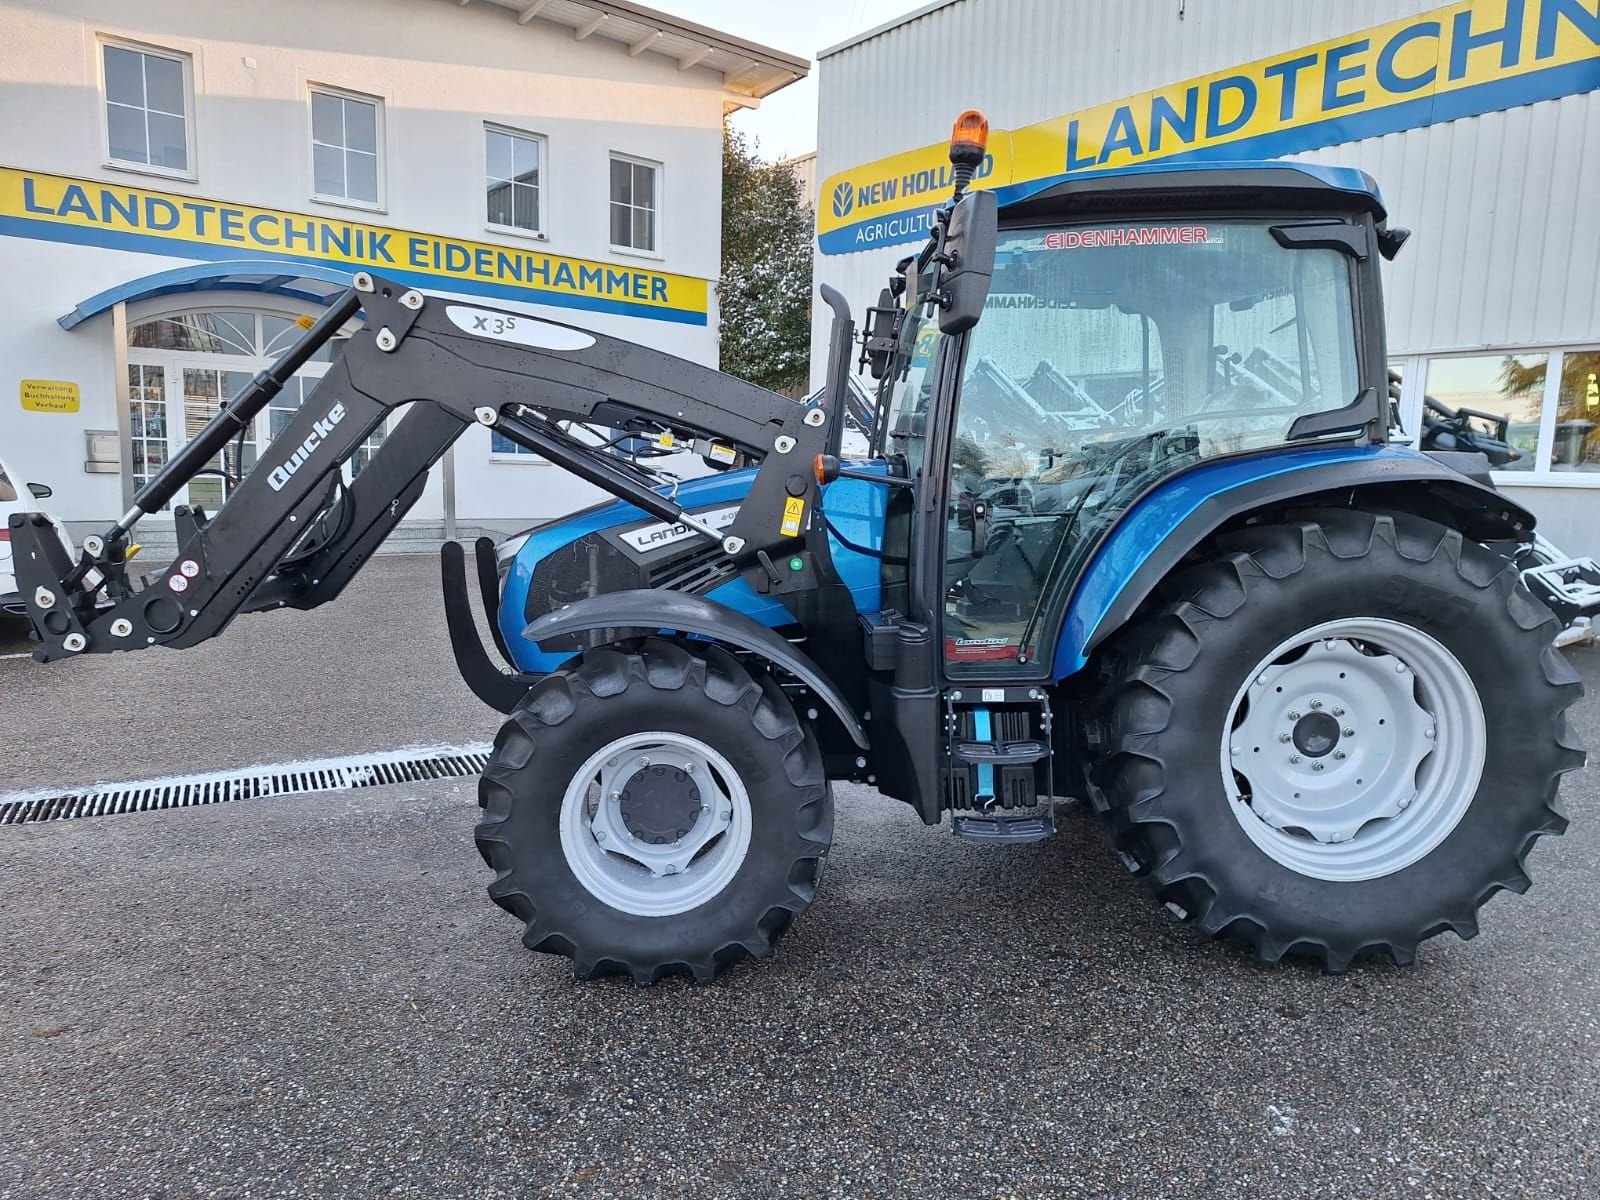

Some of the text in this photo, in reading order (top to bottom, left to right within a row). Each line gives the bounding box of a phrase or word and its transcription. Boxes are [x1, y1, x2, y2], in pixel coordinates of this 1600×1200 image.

[858, 154, 994, 208] NEW HOLLD
[23, 178, 668, 302] LANDTECHNIK EIDENHAMMER
[856, 212, 934, 244] AGRICULTU
[24, 392, 76, 402] Buchhaltung
[27, 384, 73, 394] Verwaltung
[35, 401, 66, 409] Verkauf
[267, 401, 346, 491] Quicke
[638, 518, 707, 546] LAND
